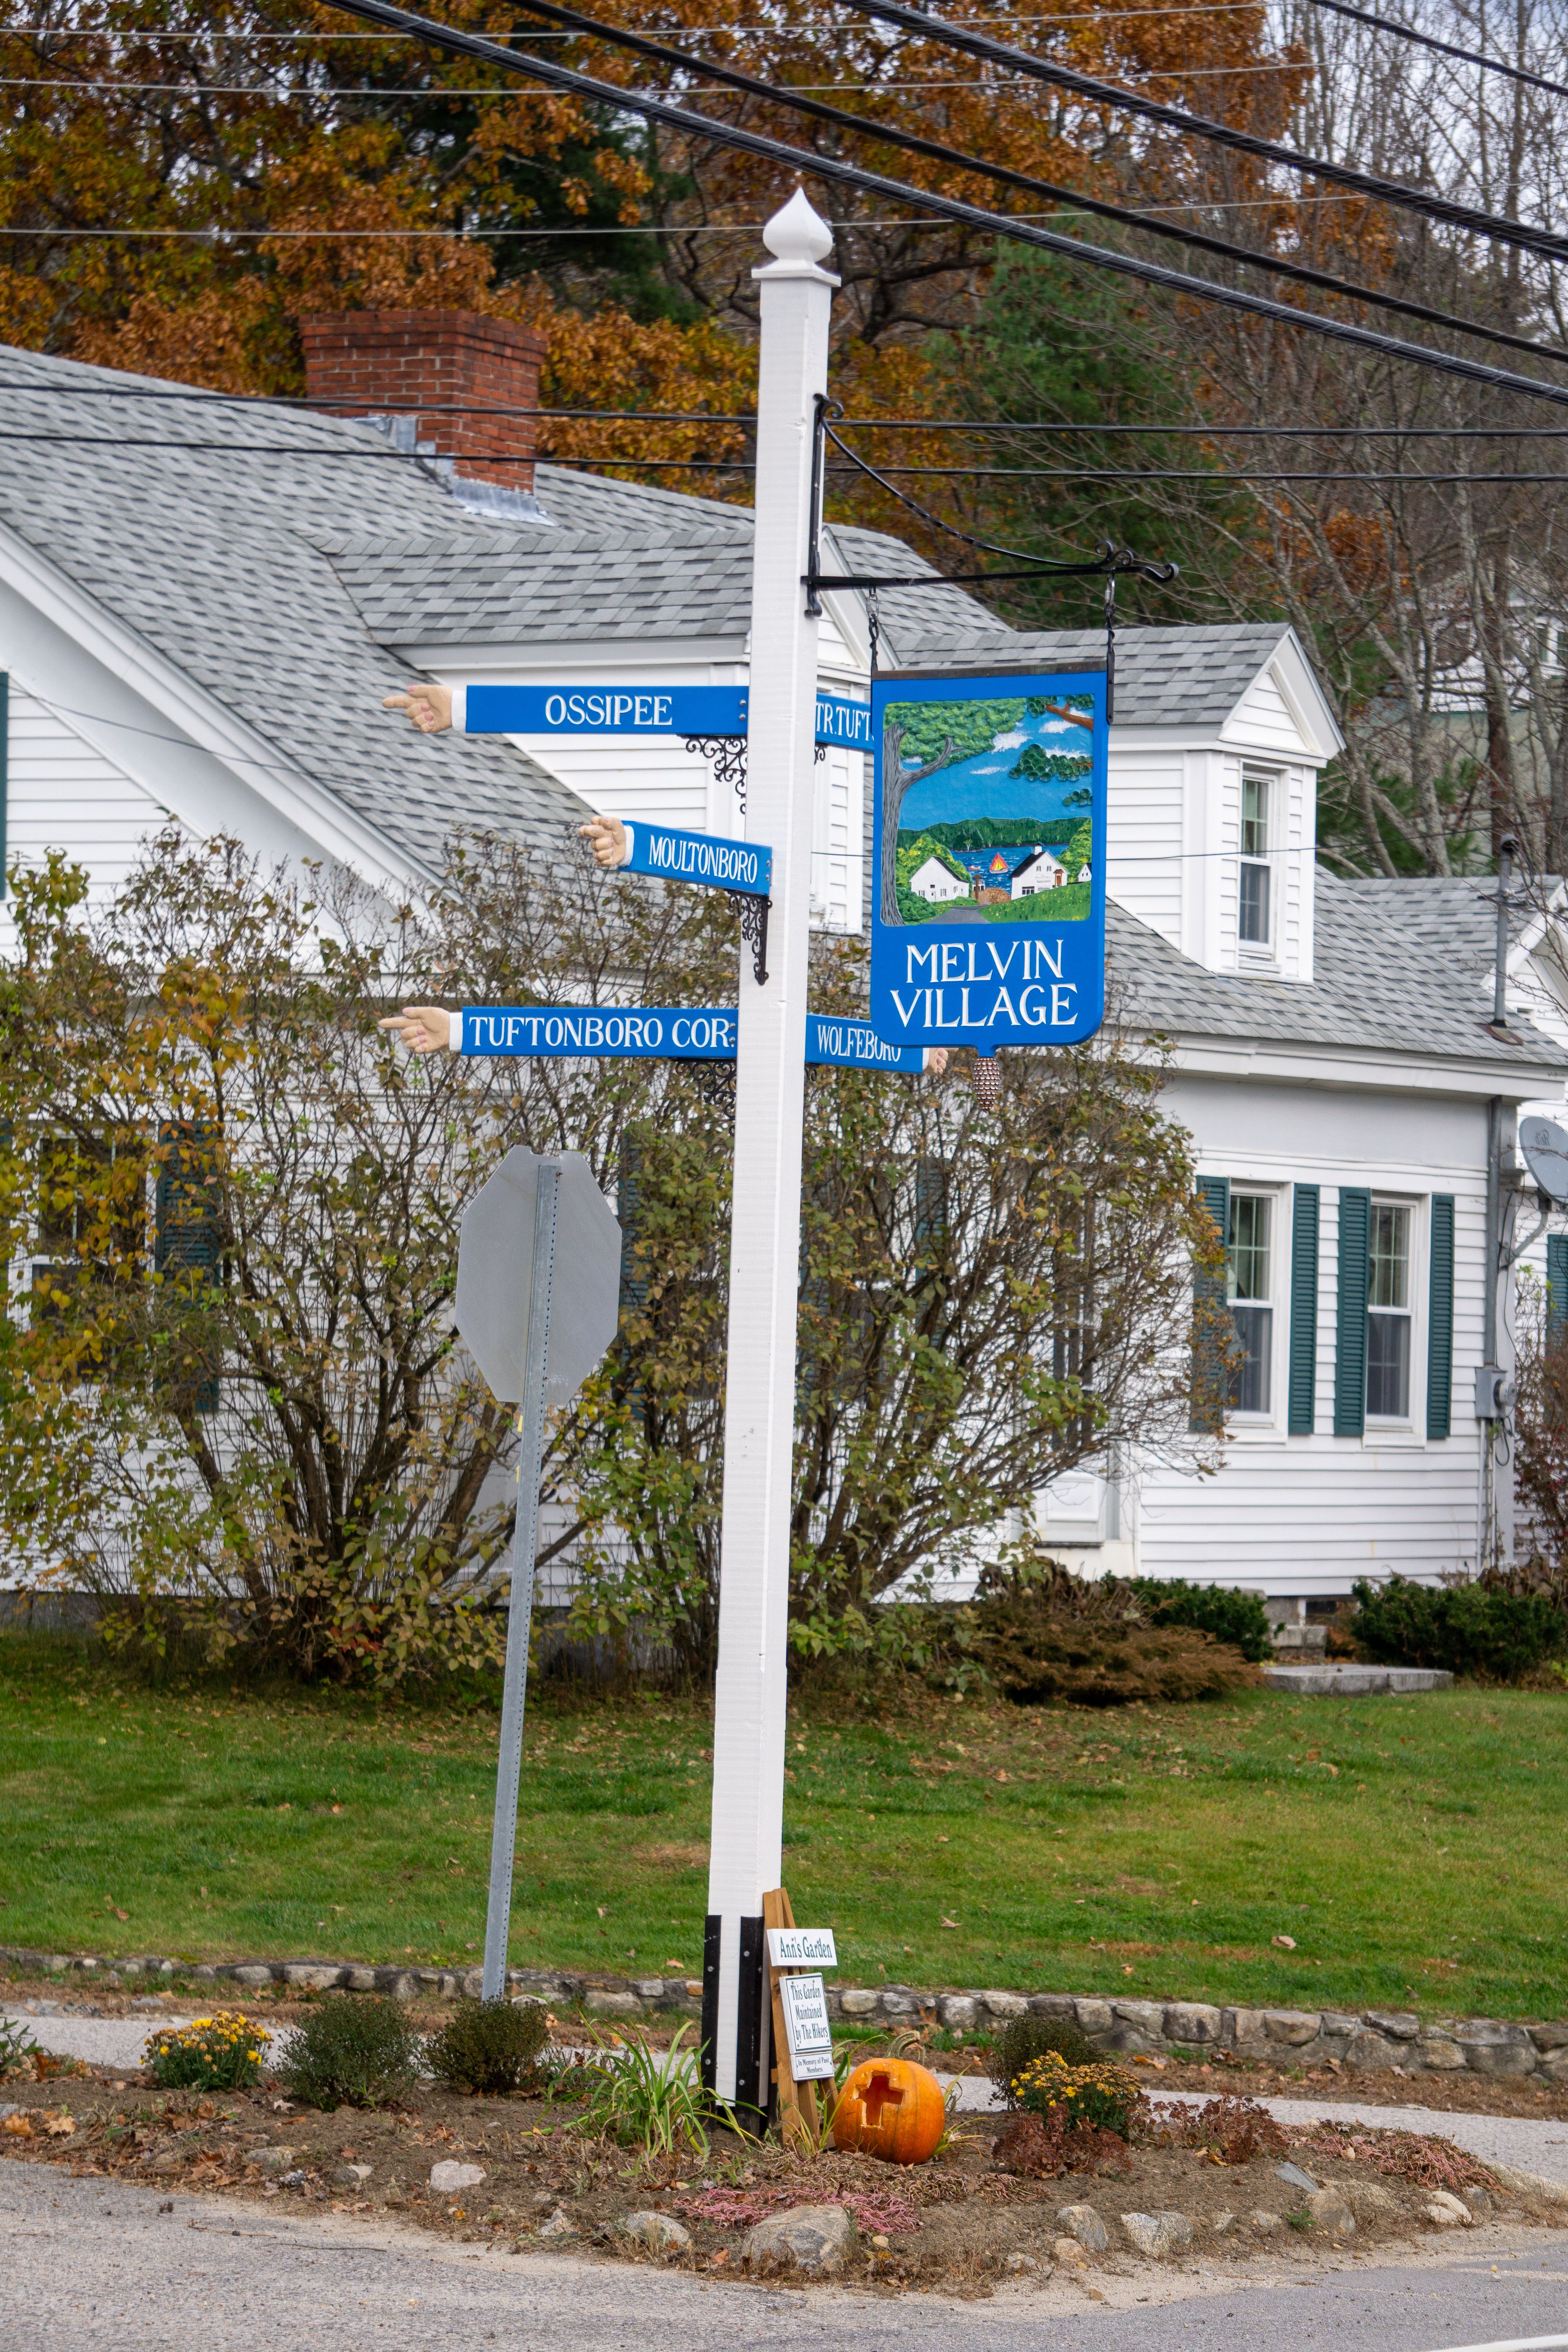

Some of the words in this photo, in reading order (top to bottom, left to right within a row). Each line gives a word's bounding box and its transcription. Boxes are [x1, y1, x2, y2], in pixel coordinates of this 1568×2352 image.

[545, 695, 672, 725] OSSIPEE
[649, 835, 757, 884] MOULTONBORO
[907, 940, 1063, 983] MELVIN
[890, 983, 1078, 1027] VILLAGE
[469, 1017, 663, 1047] TUFTONBORO
[672, 1018, 734, 1048] COR.
[780, 1936, 802, 1958] Ann's
[802, 1936, 833, 1958] Garden
[791, 1985, 803, 2000] This
[804, 1984, 821, 1999] Garden
[795, 2003, 822, 2020] Maintained
[795, 2026, 801, 2043] by
[802, 2024, 811, 2040] The
[811, 2023, 828, 2038] Hikers
